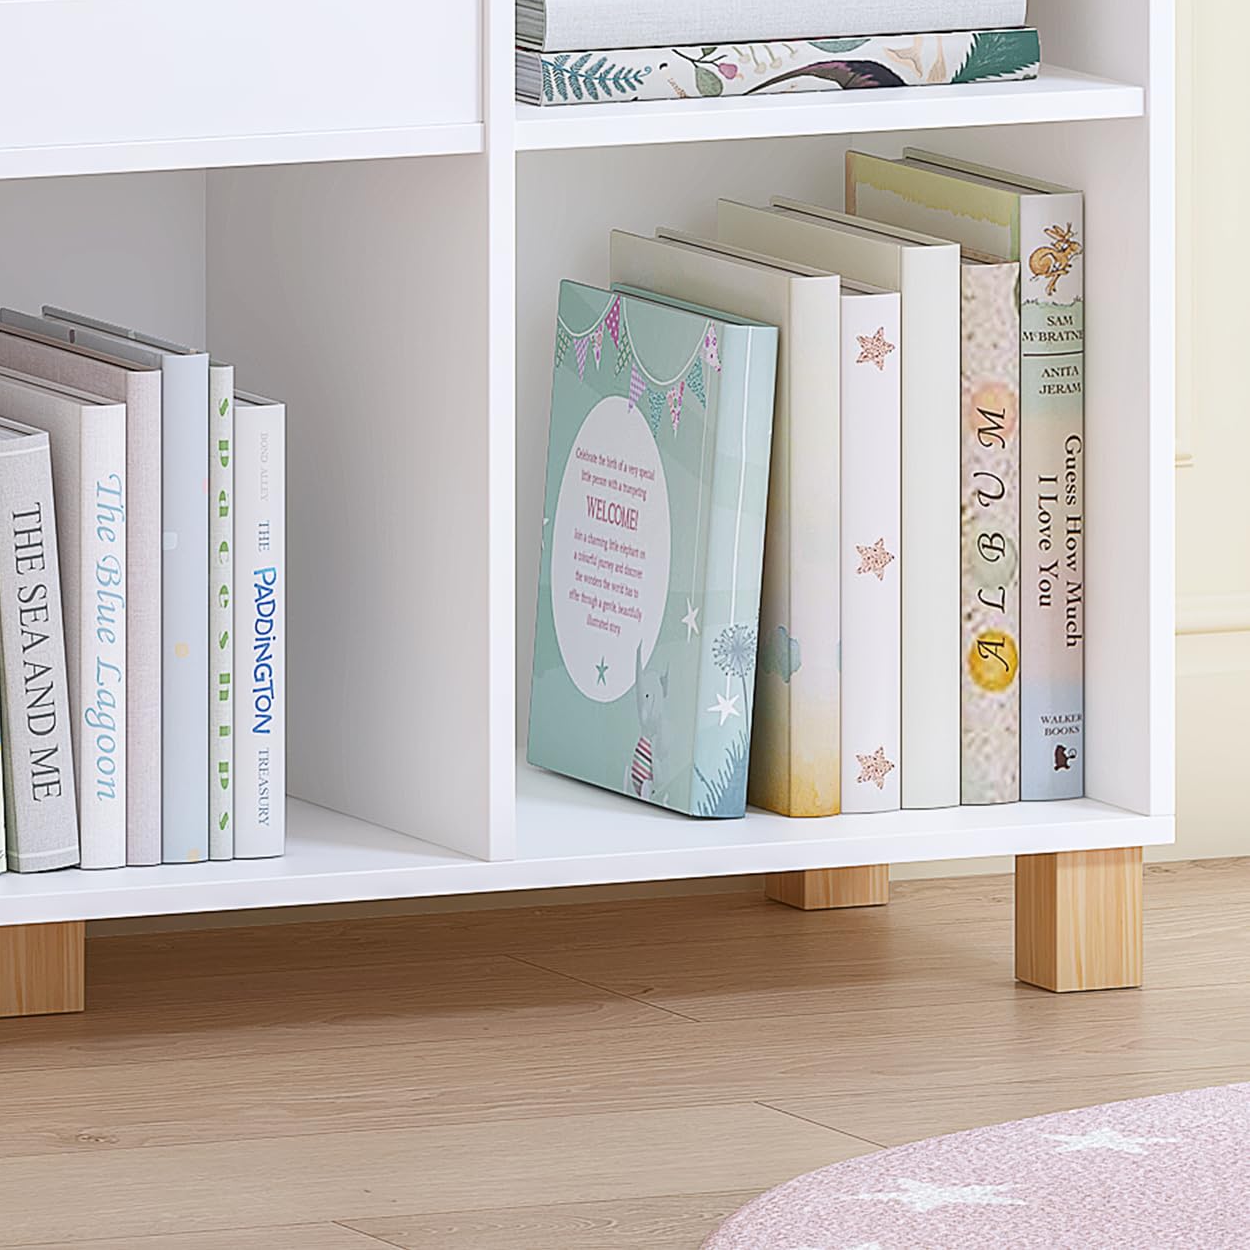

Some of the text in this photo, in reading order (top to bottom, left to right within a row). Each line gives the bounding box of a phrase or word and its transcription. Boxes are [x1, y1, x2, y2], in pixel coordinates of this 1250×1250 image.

[1039, 382, 1081, 395] JERAM
[1041, 365, 1079, 378] ANITA
[1046, 315, 1073, 326] SAM
[586, 495, 639, 531] WELCOME!
[973, 407, 1009, 671] ALBUM
[1038, 475, 1059, 607] I Love You
[1064, 434, 1083, 647] Guess How Much
[12, 502, 62, 802] THE SEA AND ME
[85, 473, 125, 801] The Blue Lagoon
[252, 519, 277, 826] THE PADDiNGTON TREASURY
